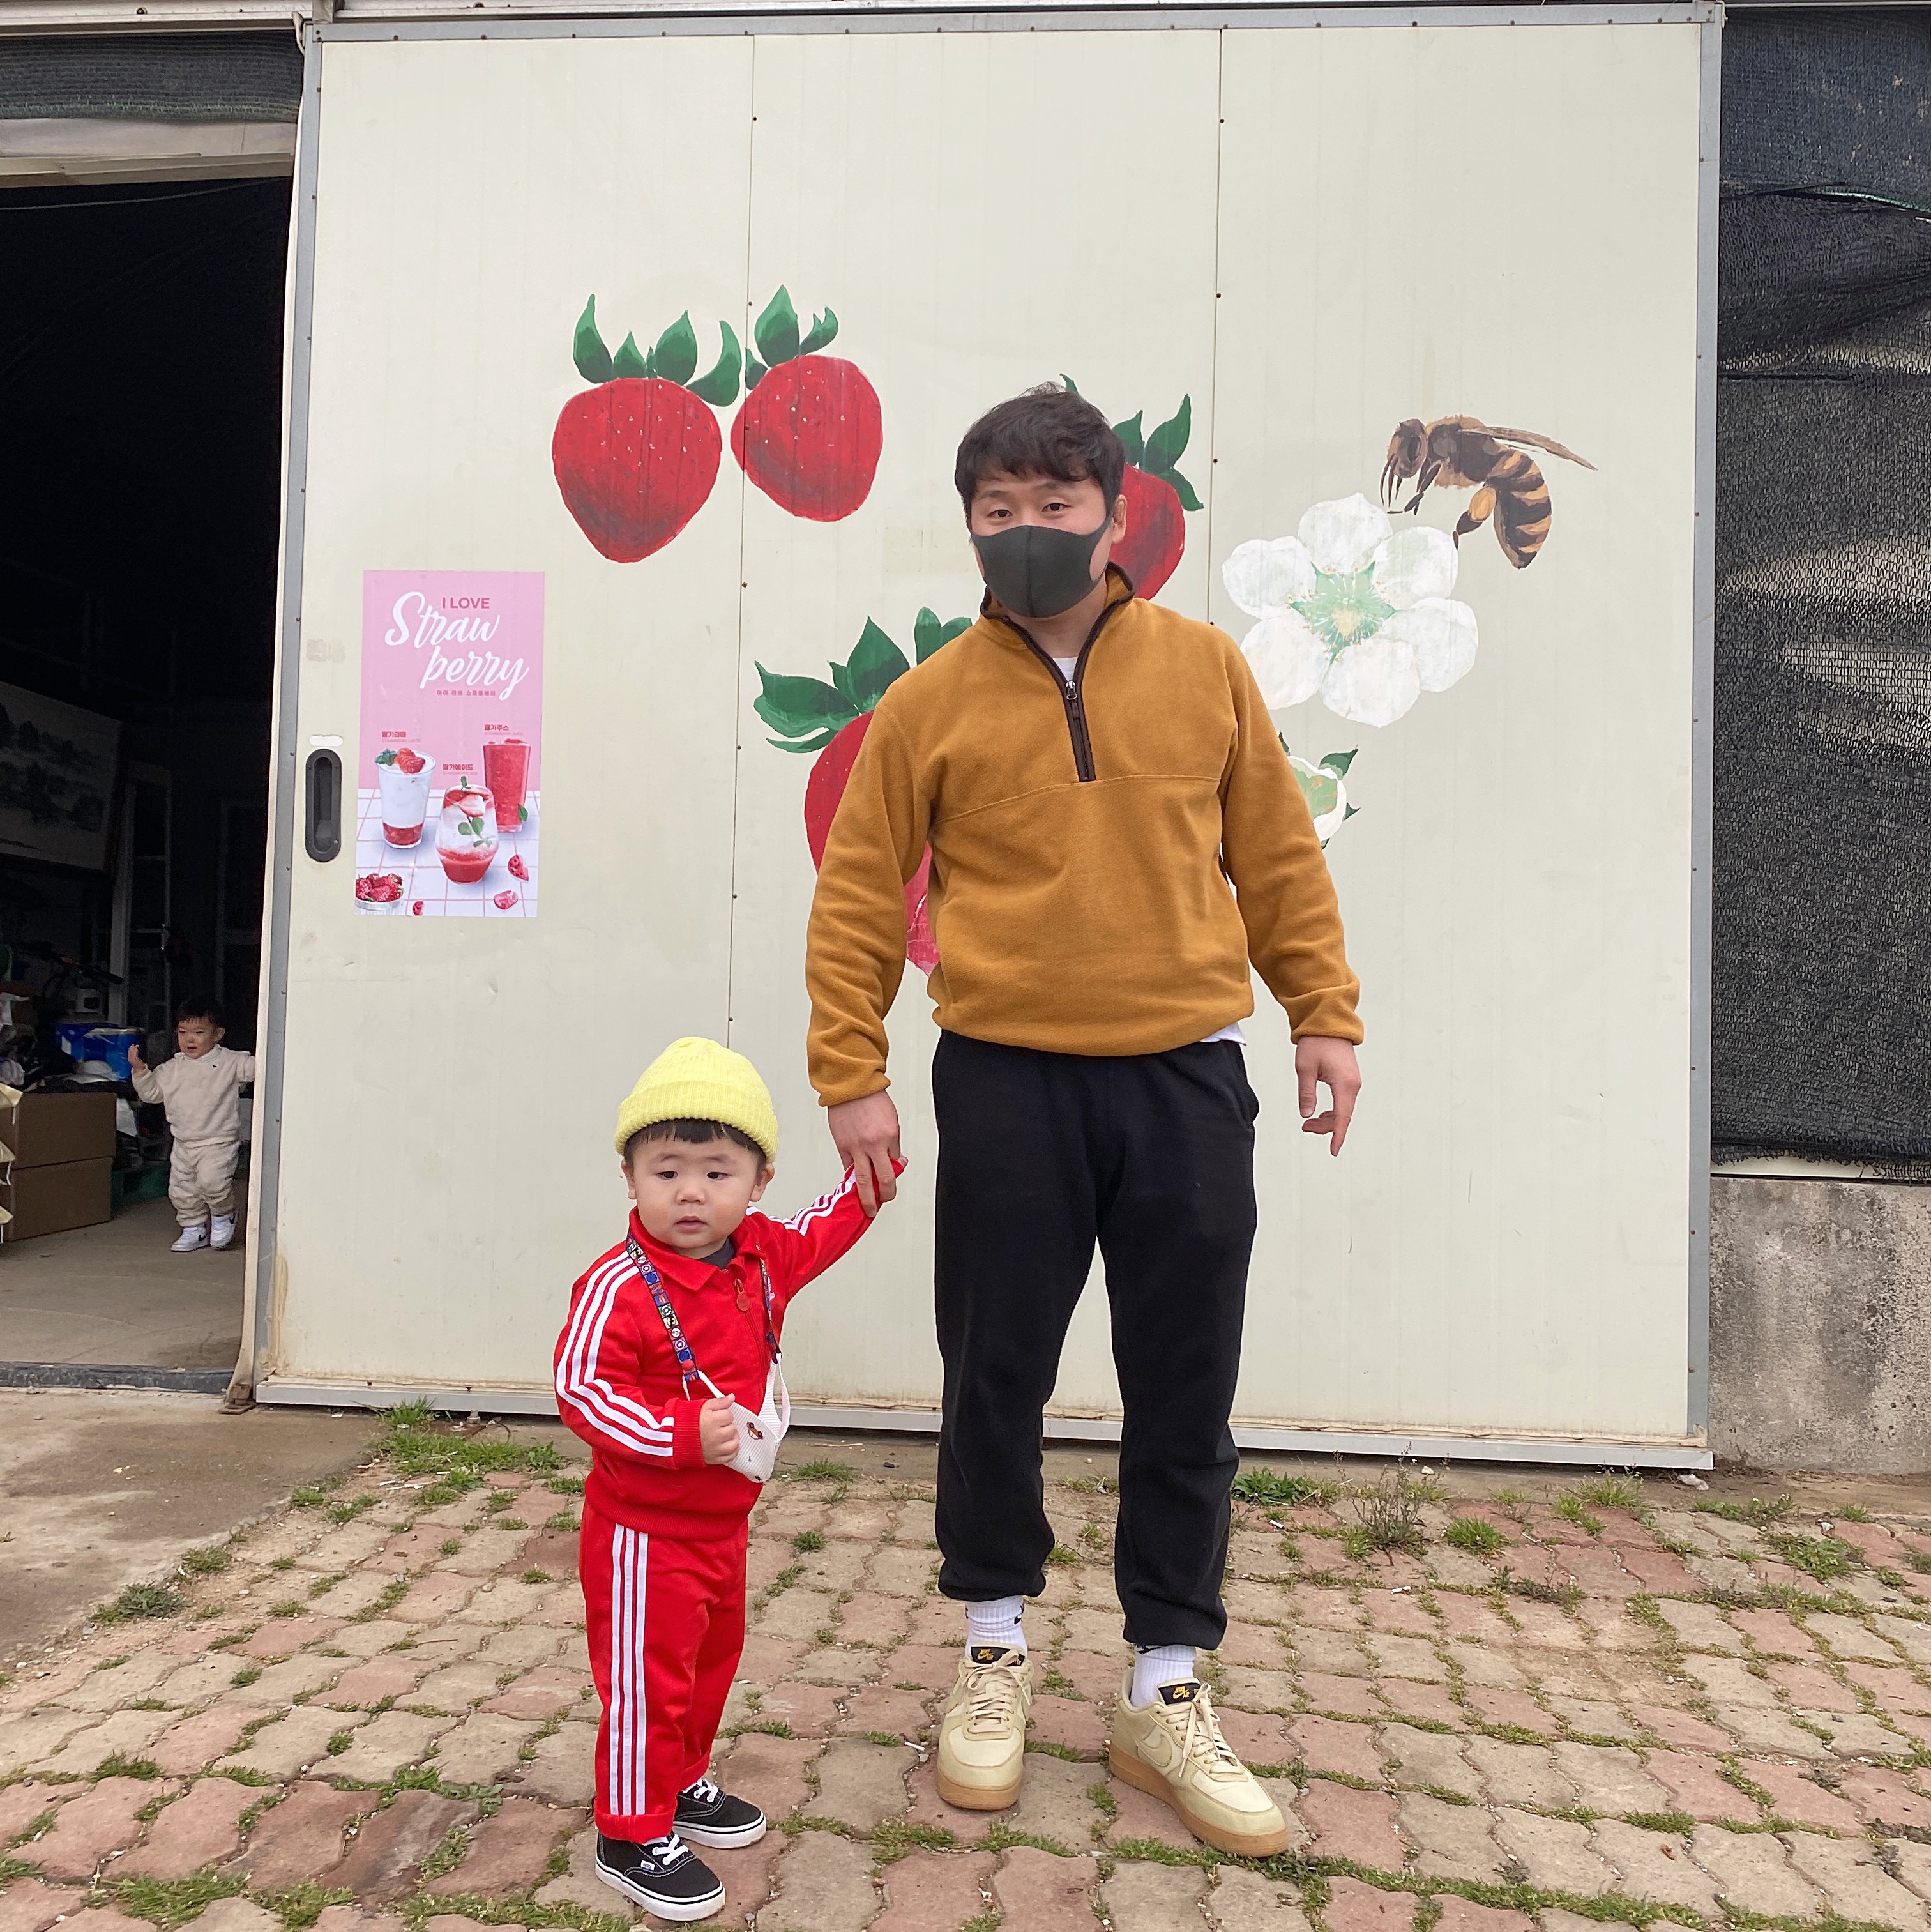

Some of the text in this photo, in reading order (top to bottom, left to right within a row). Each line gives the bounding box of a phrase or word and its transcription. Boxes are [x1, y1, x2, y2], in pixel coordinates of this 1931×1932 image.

[384, 591, 501, 648] Straw
[442, 597, 490, 609] I LOVE
